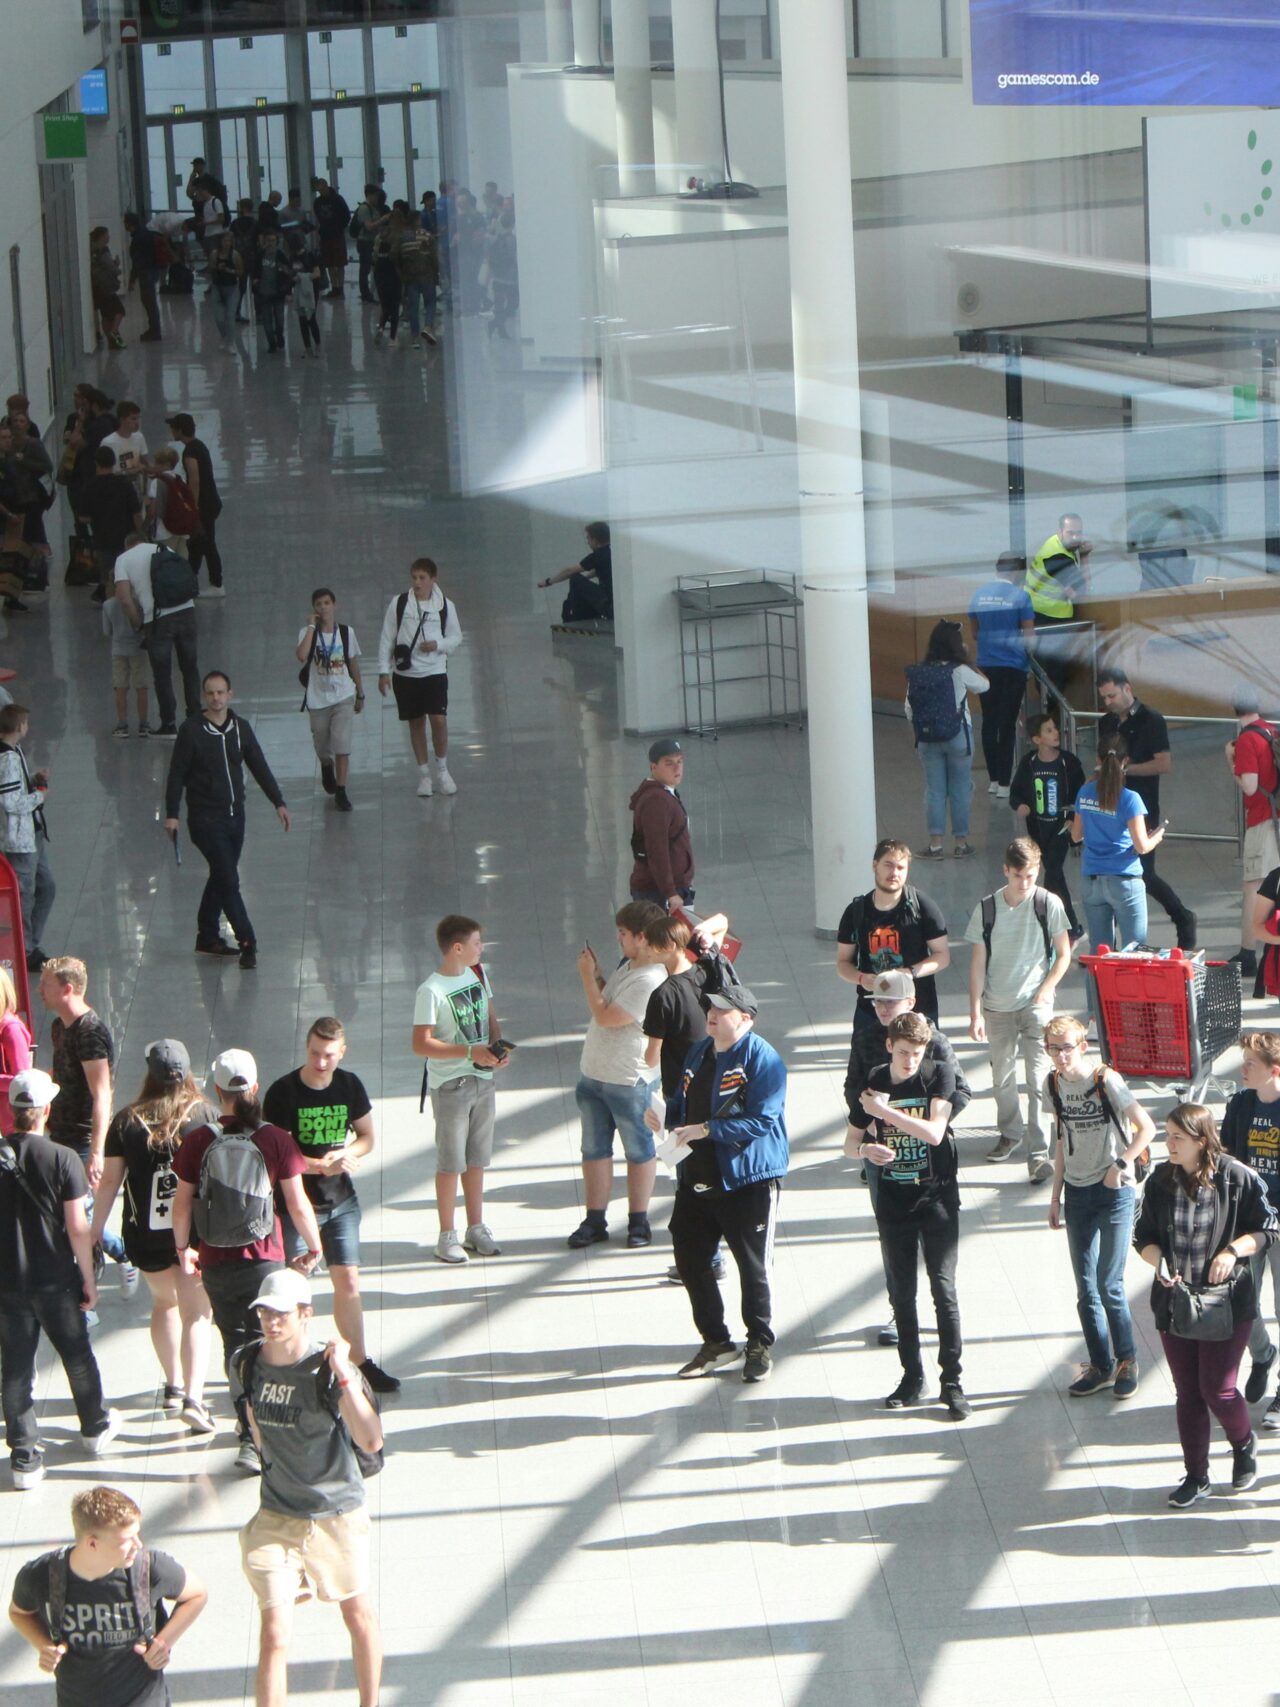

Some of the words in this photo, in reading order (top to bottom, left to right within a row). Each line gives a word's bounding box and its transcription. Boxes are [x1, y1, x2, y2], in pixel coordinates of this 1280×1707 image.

[997, 72, 1099, 88] gamescom.de
[1066, 1094, 1085, 1102] REAL
[297, 1105, 348, 1117] UNFAIR
[299, 1116, 348, 1132] DONT
[1252, 1116, 1273, 1128] REAL
[298, 1129, 346, 1145] CARE
[894, 1146, 928, 1161] USIC
[260, 1383, 296, 1405] FAST
